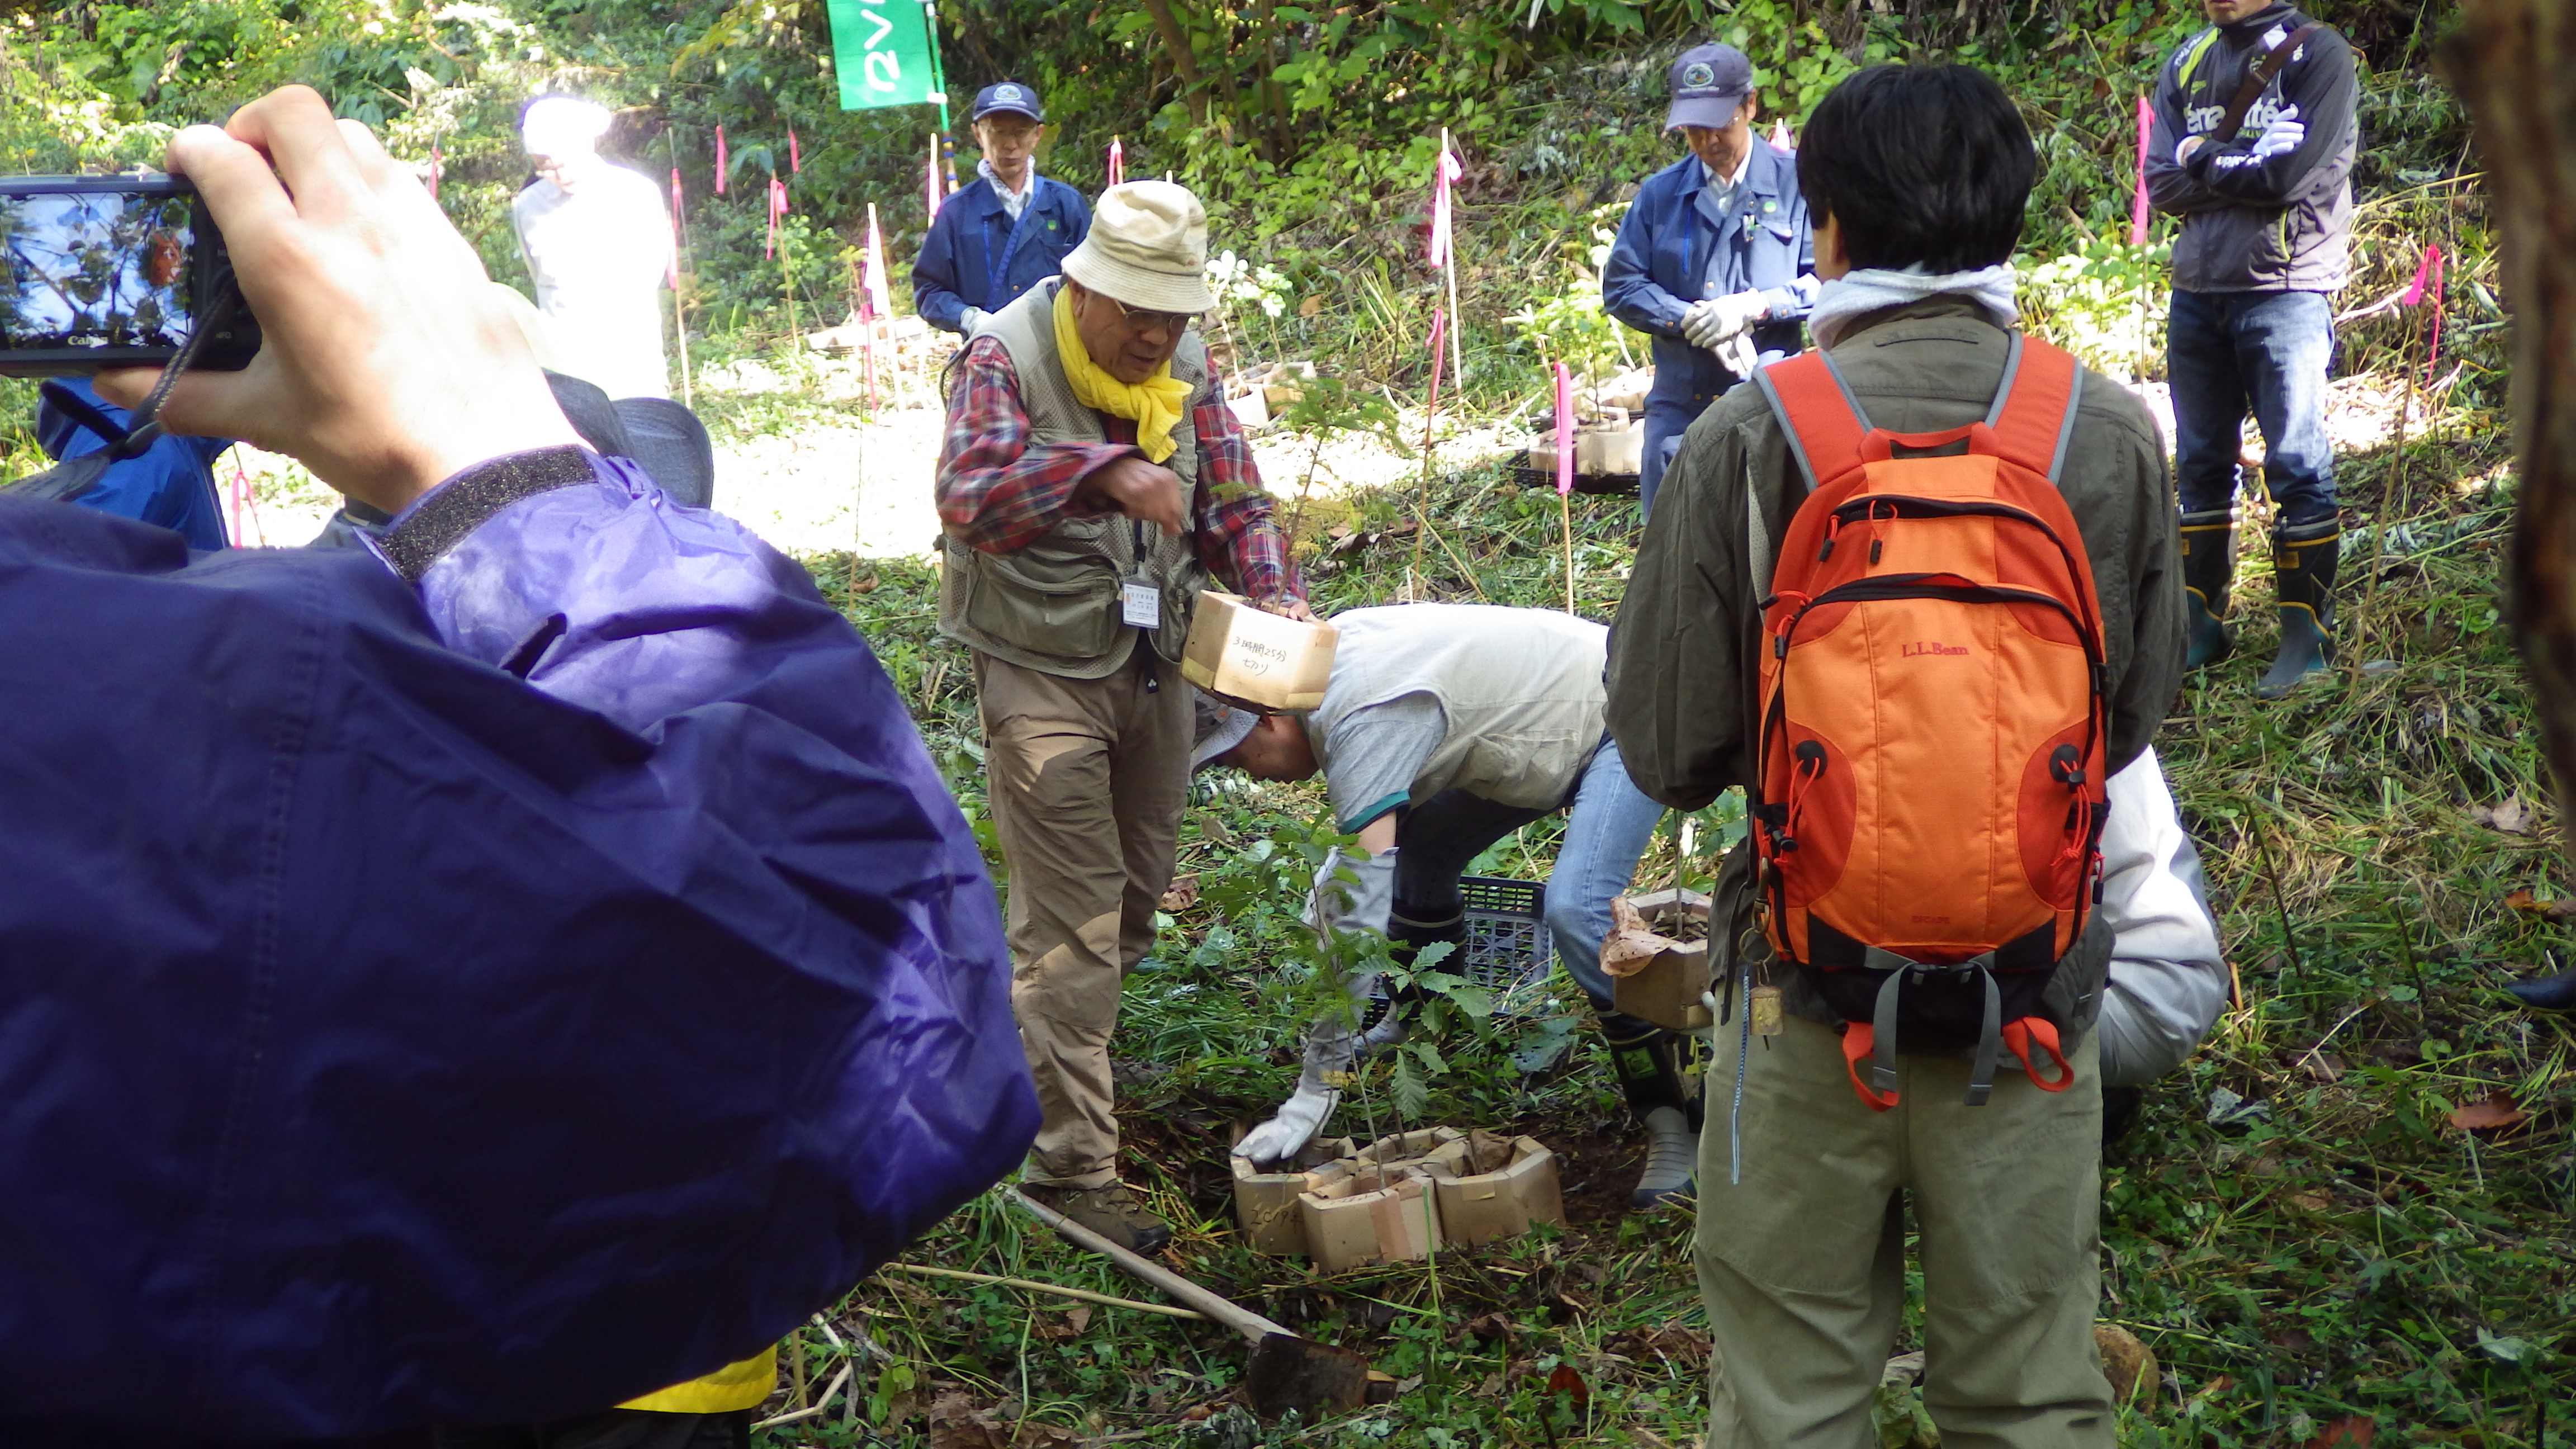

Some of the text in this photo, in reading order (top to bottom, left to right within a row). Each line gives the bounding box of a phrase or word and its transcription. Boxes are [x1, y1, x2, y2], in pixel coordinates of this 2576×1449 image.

[1232, 636, 1287, 662] 3時間25分
[1902, 641, 1969, 658] L.L.Bean
